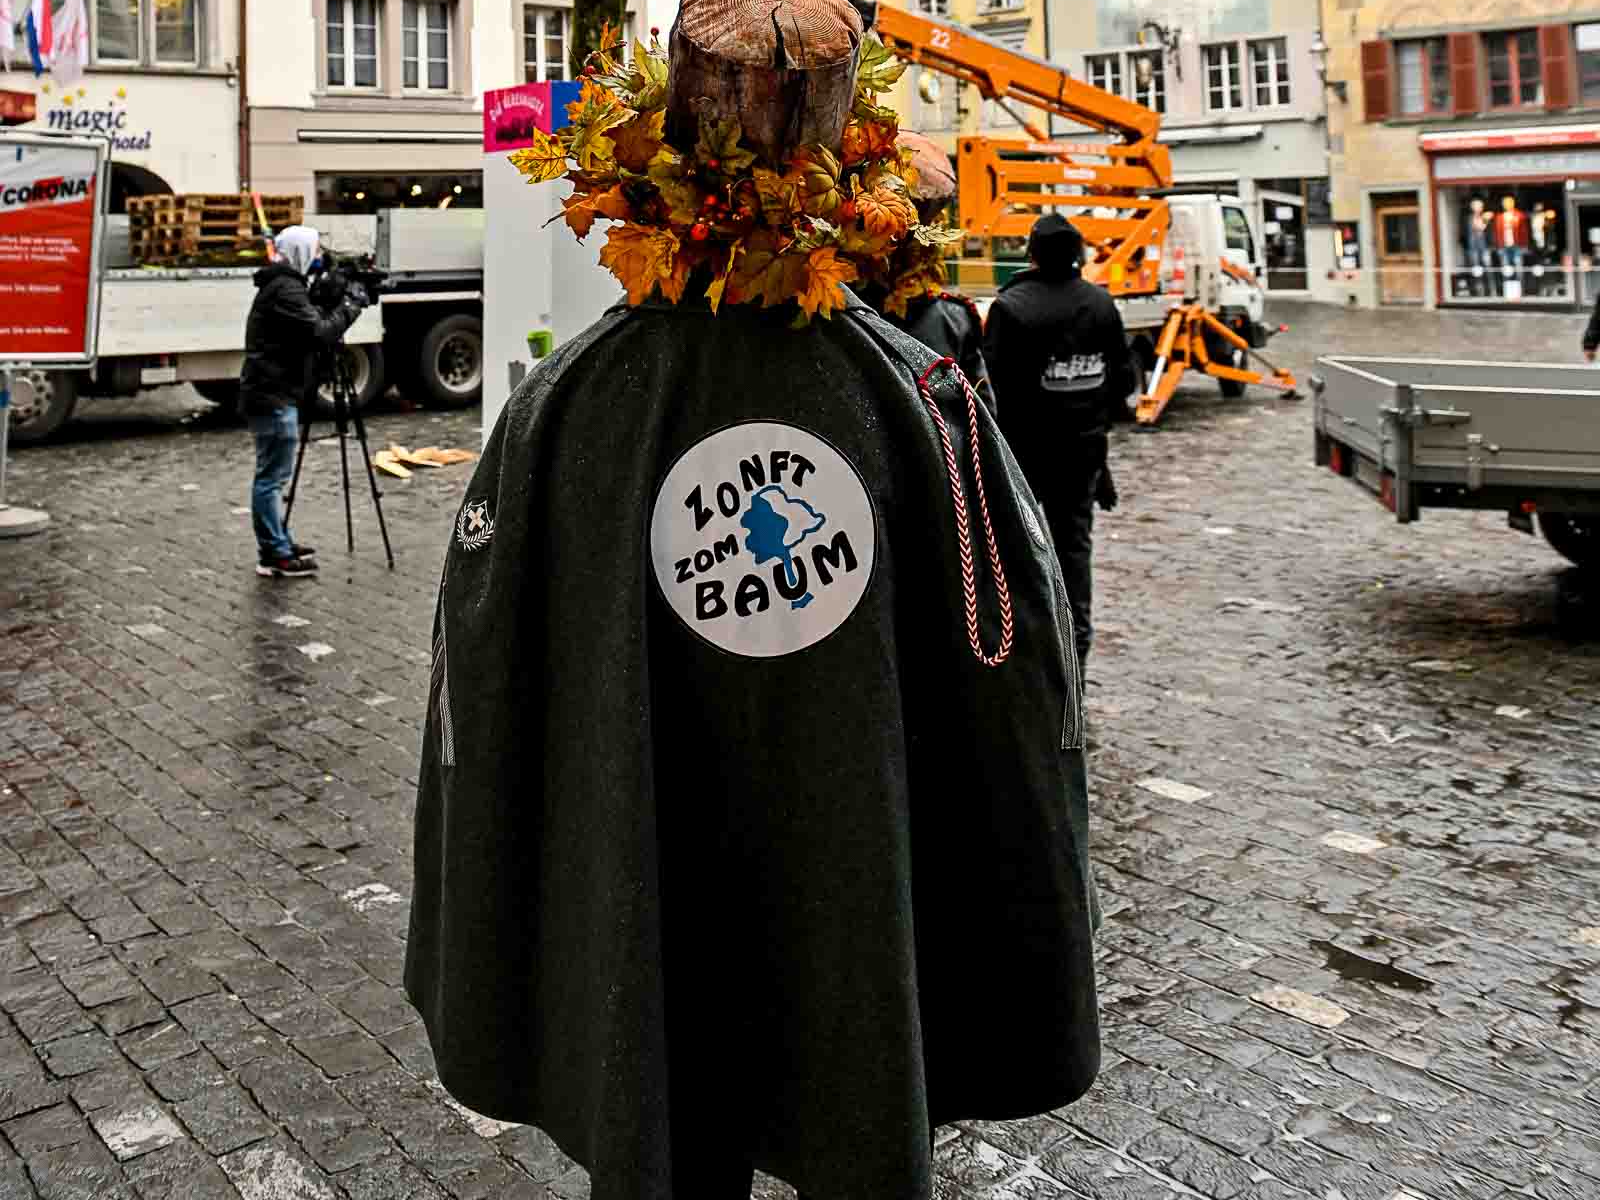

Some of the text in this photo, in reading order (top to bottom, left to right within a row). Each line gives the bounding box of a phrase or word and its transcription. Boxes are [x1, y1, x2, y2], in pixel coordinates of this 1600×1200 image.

[930, 29, 951, 49] 22
[47, 101, 126, 132] magic
[110, 131, 151, 149] hotel
[3, 179, 88, 205] CORONA
[684, 450, 816, 532] ZONFT
[674, 533, 740, 584] ZOM
[695, 530, 858, 621] BAUM
